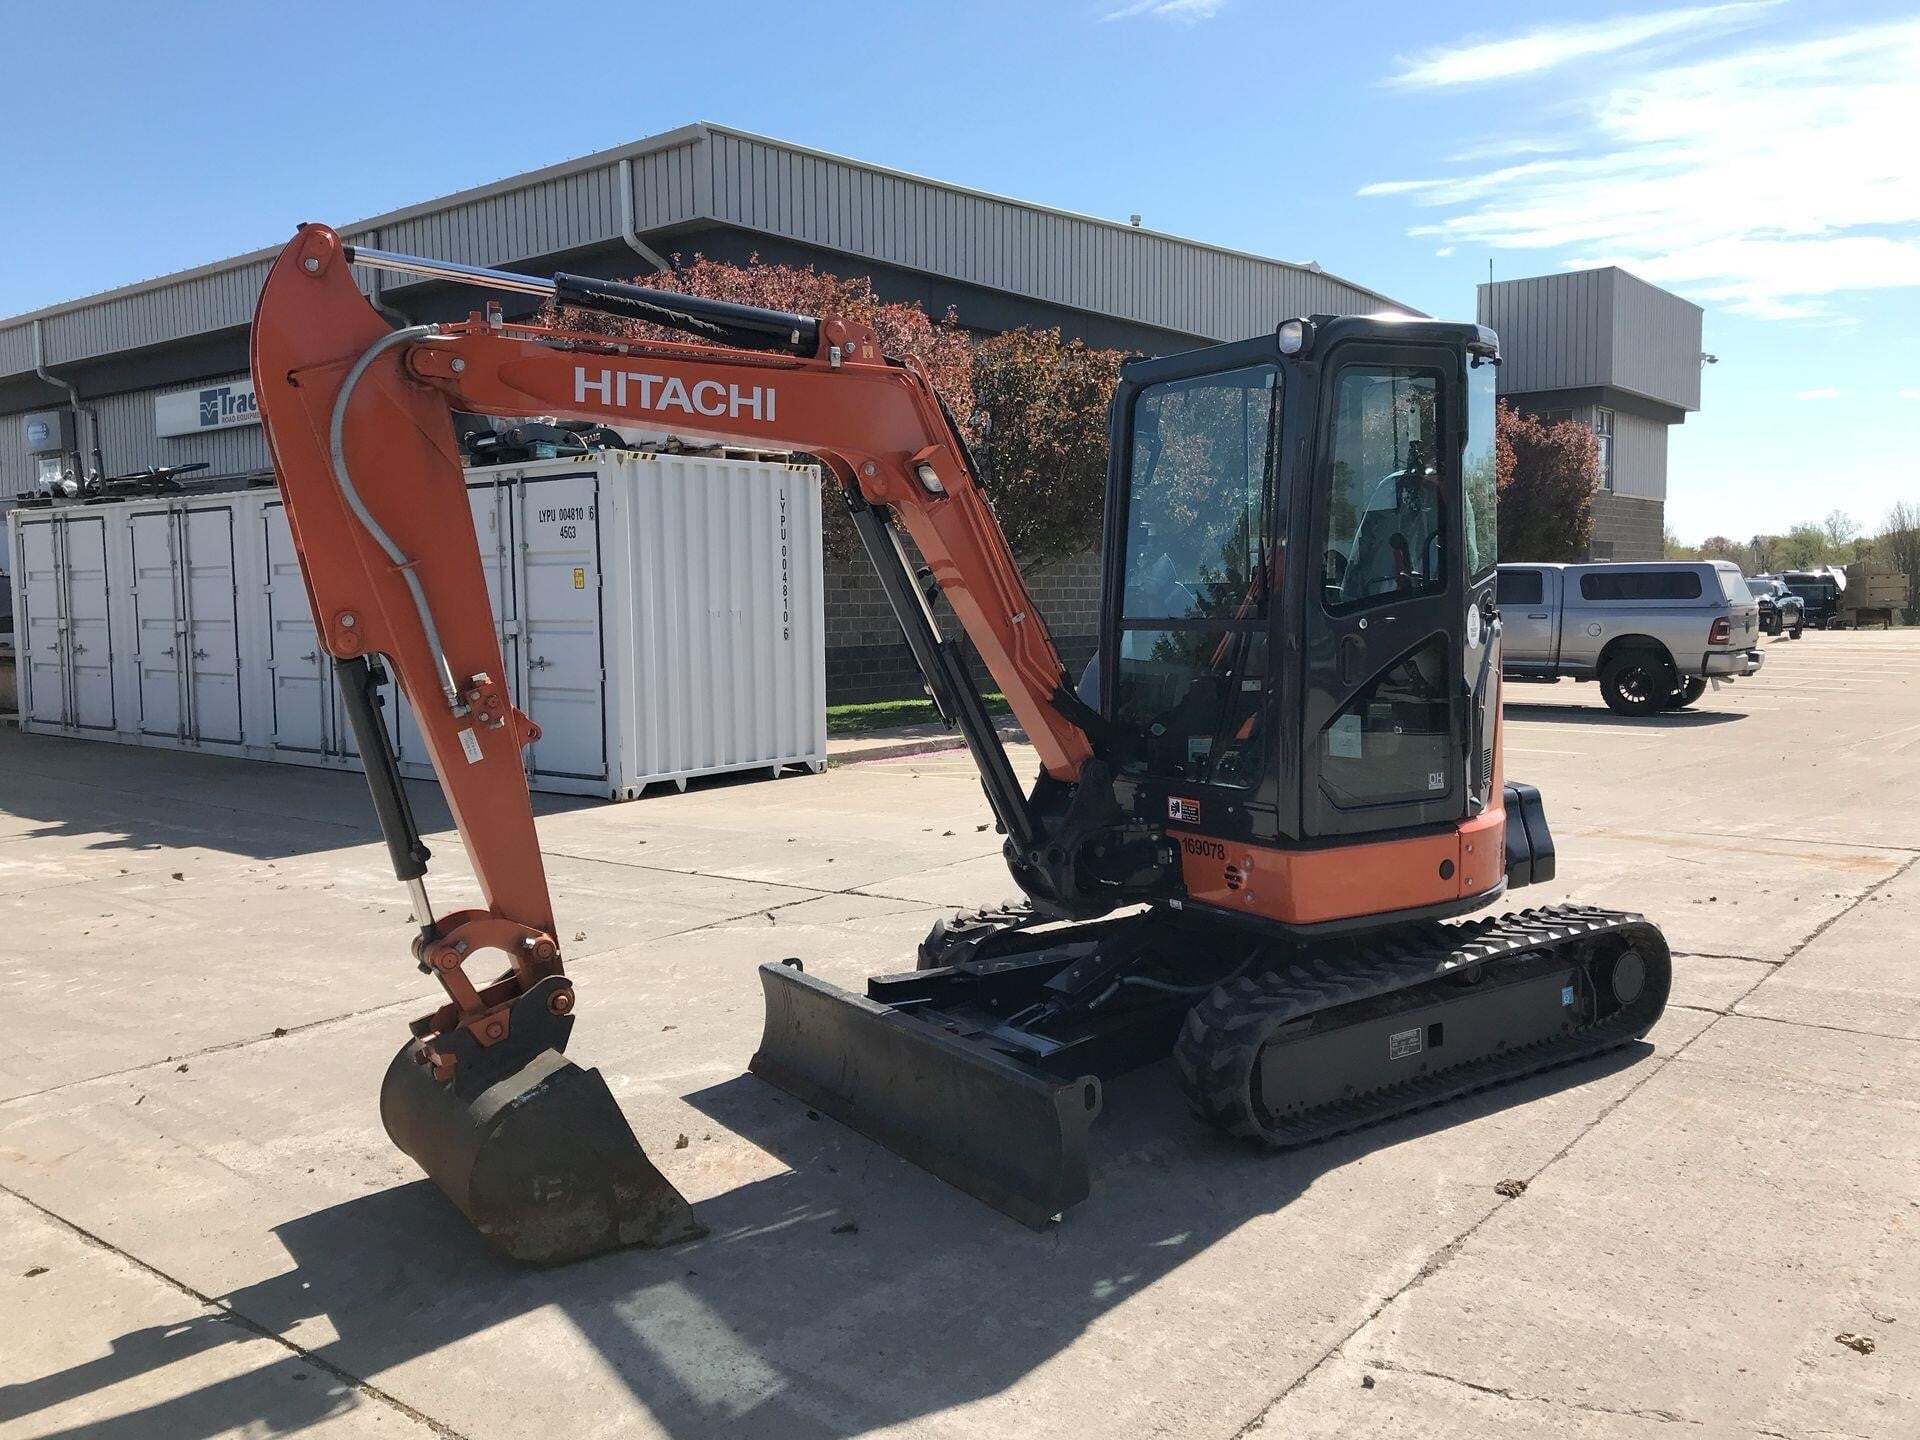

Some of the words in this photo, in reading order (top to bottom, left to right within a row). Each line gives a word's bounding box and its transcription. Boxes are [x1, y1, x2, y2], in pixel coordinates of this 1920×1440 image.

[574, 366, 776, 422] HITACHI
[222, 415, 236, 424] ROAD
[538, 509, 556, 523] LYPU
[559, 507, 584, 521] 004810
[560, 526, 576, 539] 45G3
[1182, 838, 1225, 861] 169078
